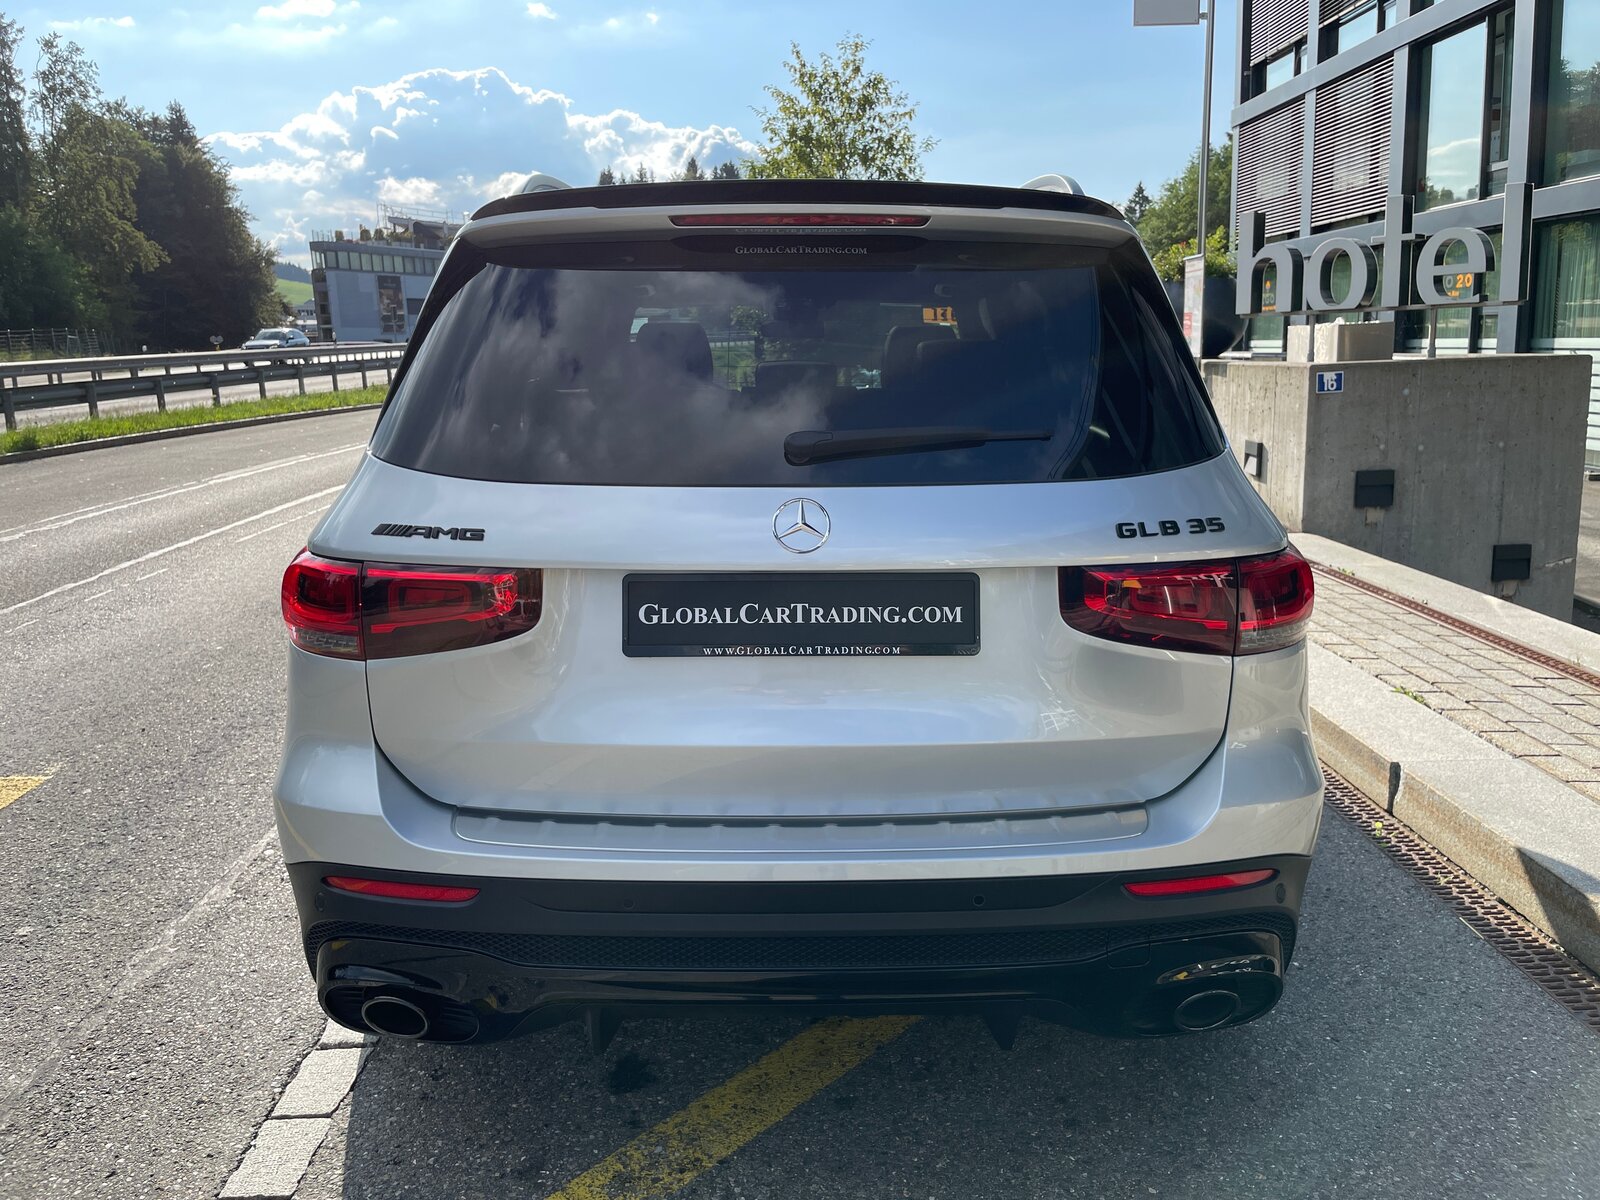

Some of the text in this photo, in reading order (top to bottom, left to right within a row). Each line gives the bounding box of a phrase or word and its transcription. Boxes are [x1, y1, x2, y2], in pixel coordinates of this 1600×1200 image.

[1236, 183, 1534, 315] hotel
[1115, 517, 1226, 539] GLB 35
